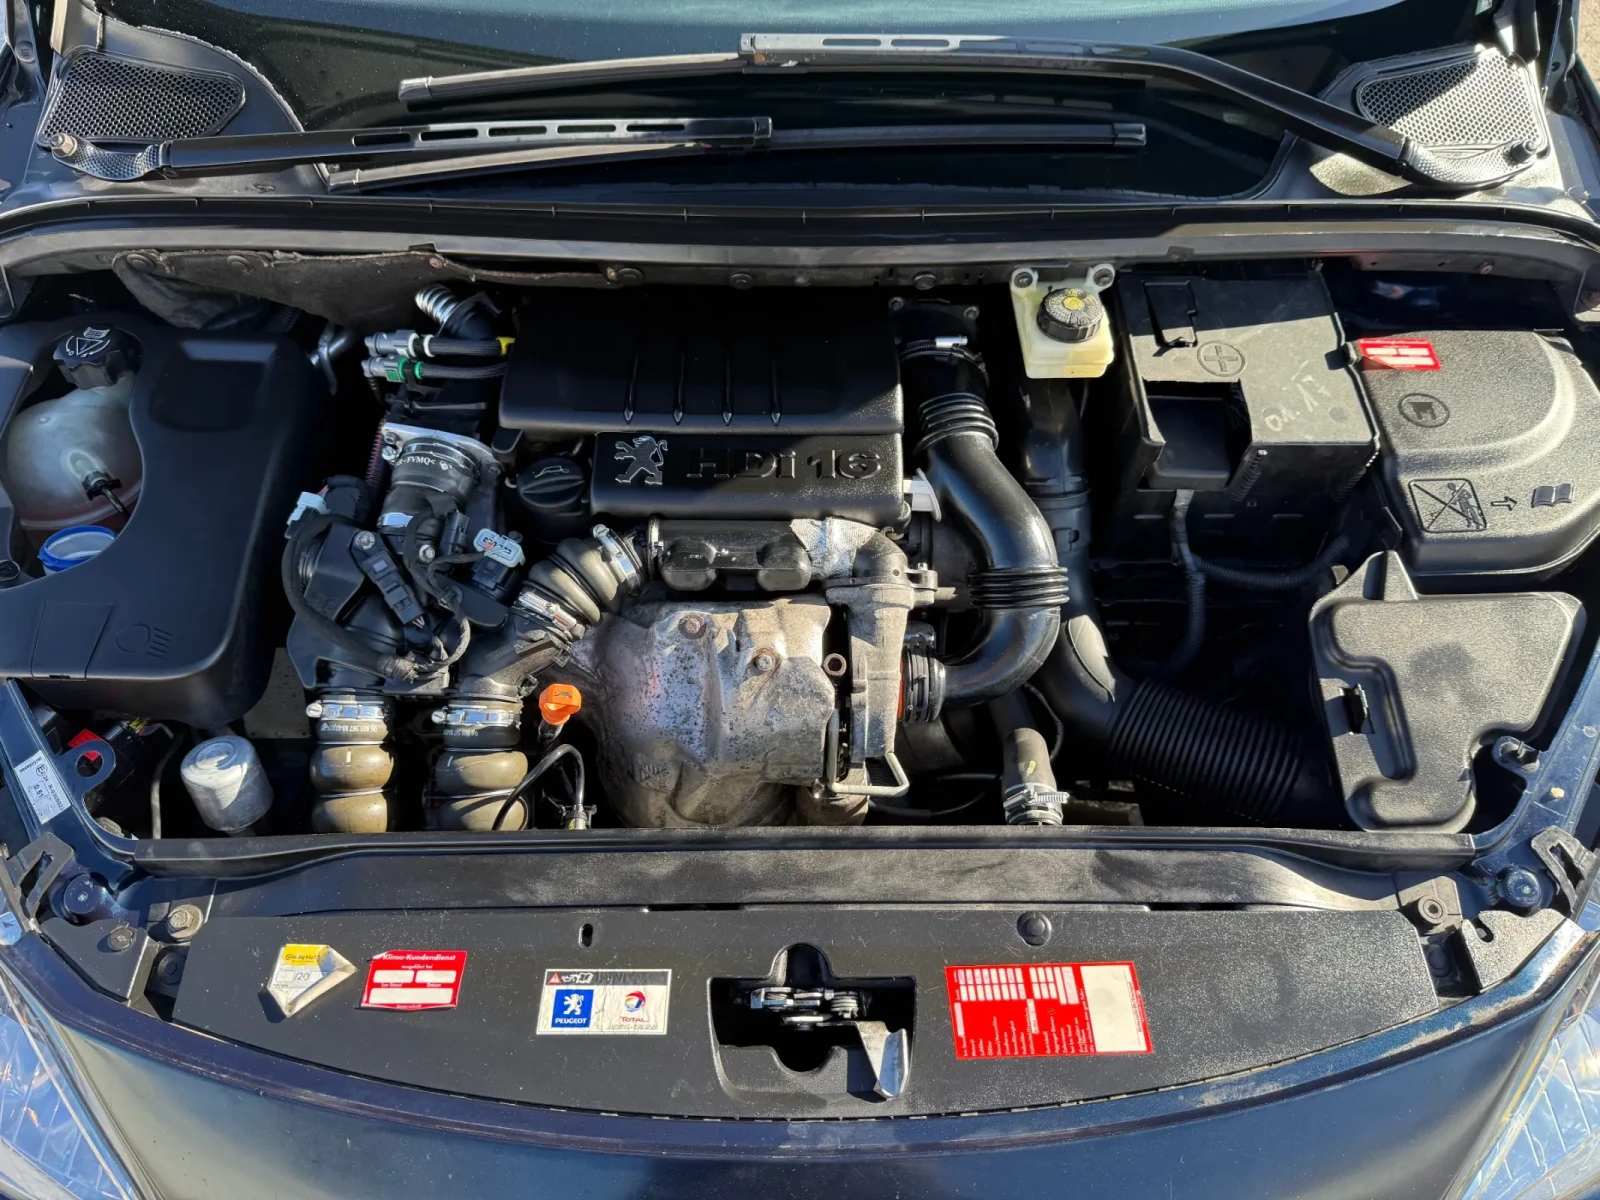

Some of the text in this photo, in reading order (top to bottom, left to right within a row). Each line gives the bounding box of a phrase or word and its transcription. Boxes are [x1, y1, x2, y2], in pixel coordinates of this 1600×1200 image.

[687, 449, 882, 479] HDi 16
[382, 953, 457, 961] Klima-Kundendienst
